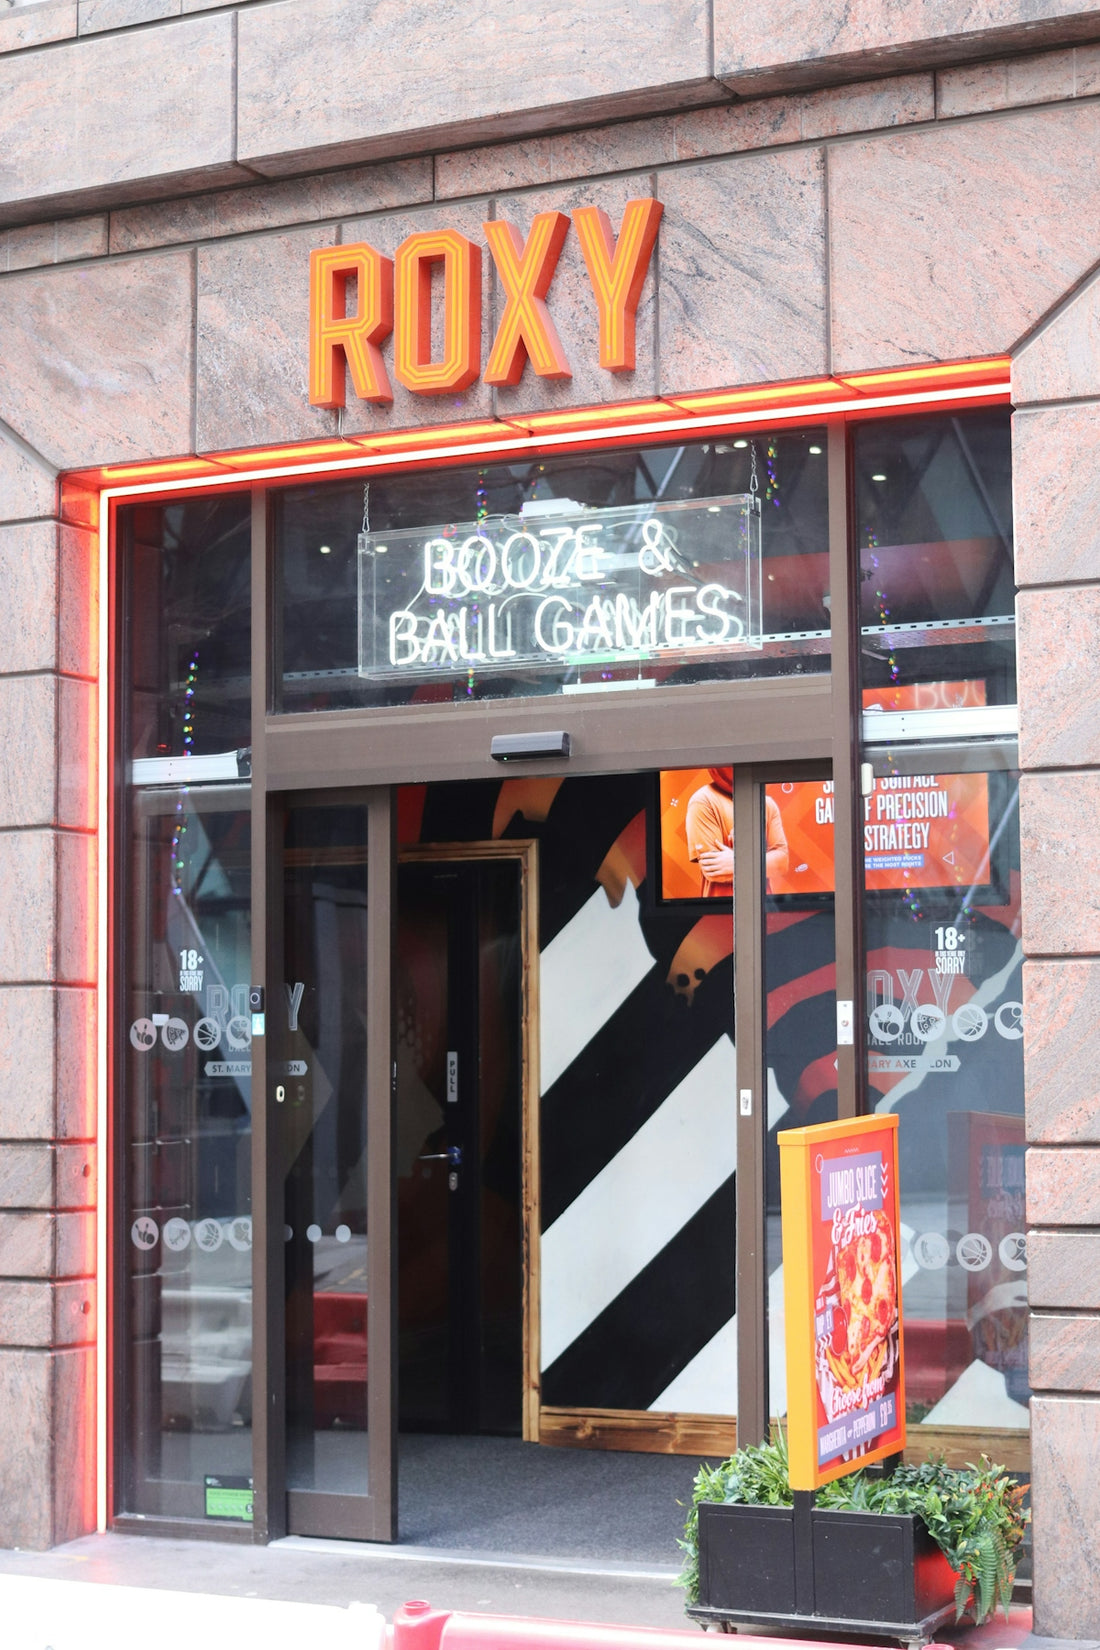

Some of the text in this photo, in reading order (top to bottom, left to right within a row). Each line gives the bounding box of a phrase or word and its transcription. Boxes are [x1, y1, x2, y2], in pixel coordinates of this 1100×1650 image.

[308, 198, 664, 408] ROXY
[424, 518, 674, 595] BOOZE &
[389, 584, 731, 666] BALL GAMES
[815, 797, 834, 824] GA
[876, 790, 948, 821] PRECISION
[864, 822, 930, 851] STRATEGY
[934, 926, 966, 950] 18+
[179, 949, 204, 970] 18+
[935, 956, 966, 974] SORRY
[179, 975, 204, 992] SORRY
[866, 968, 955, 1023] OXY
[212, 1064, 300, 1073] ST. MARY DN
[896, 1060, 916, 1068] AXE
[827, 1165, 878, 1208] JUMBO SLICE
[831, 1374, 886, 1415] Choose from
